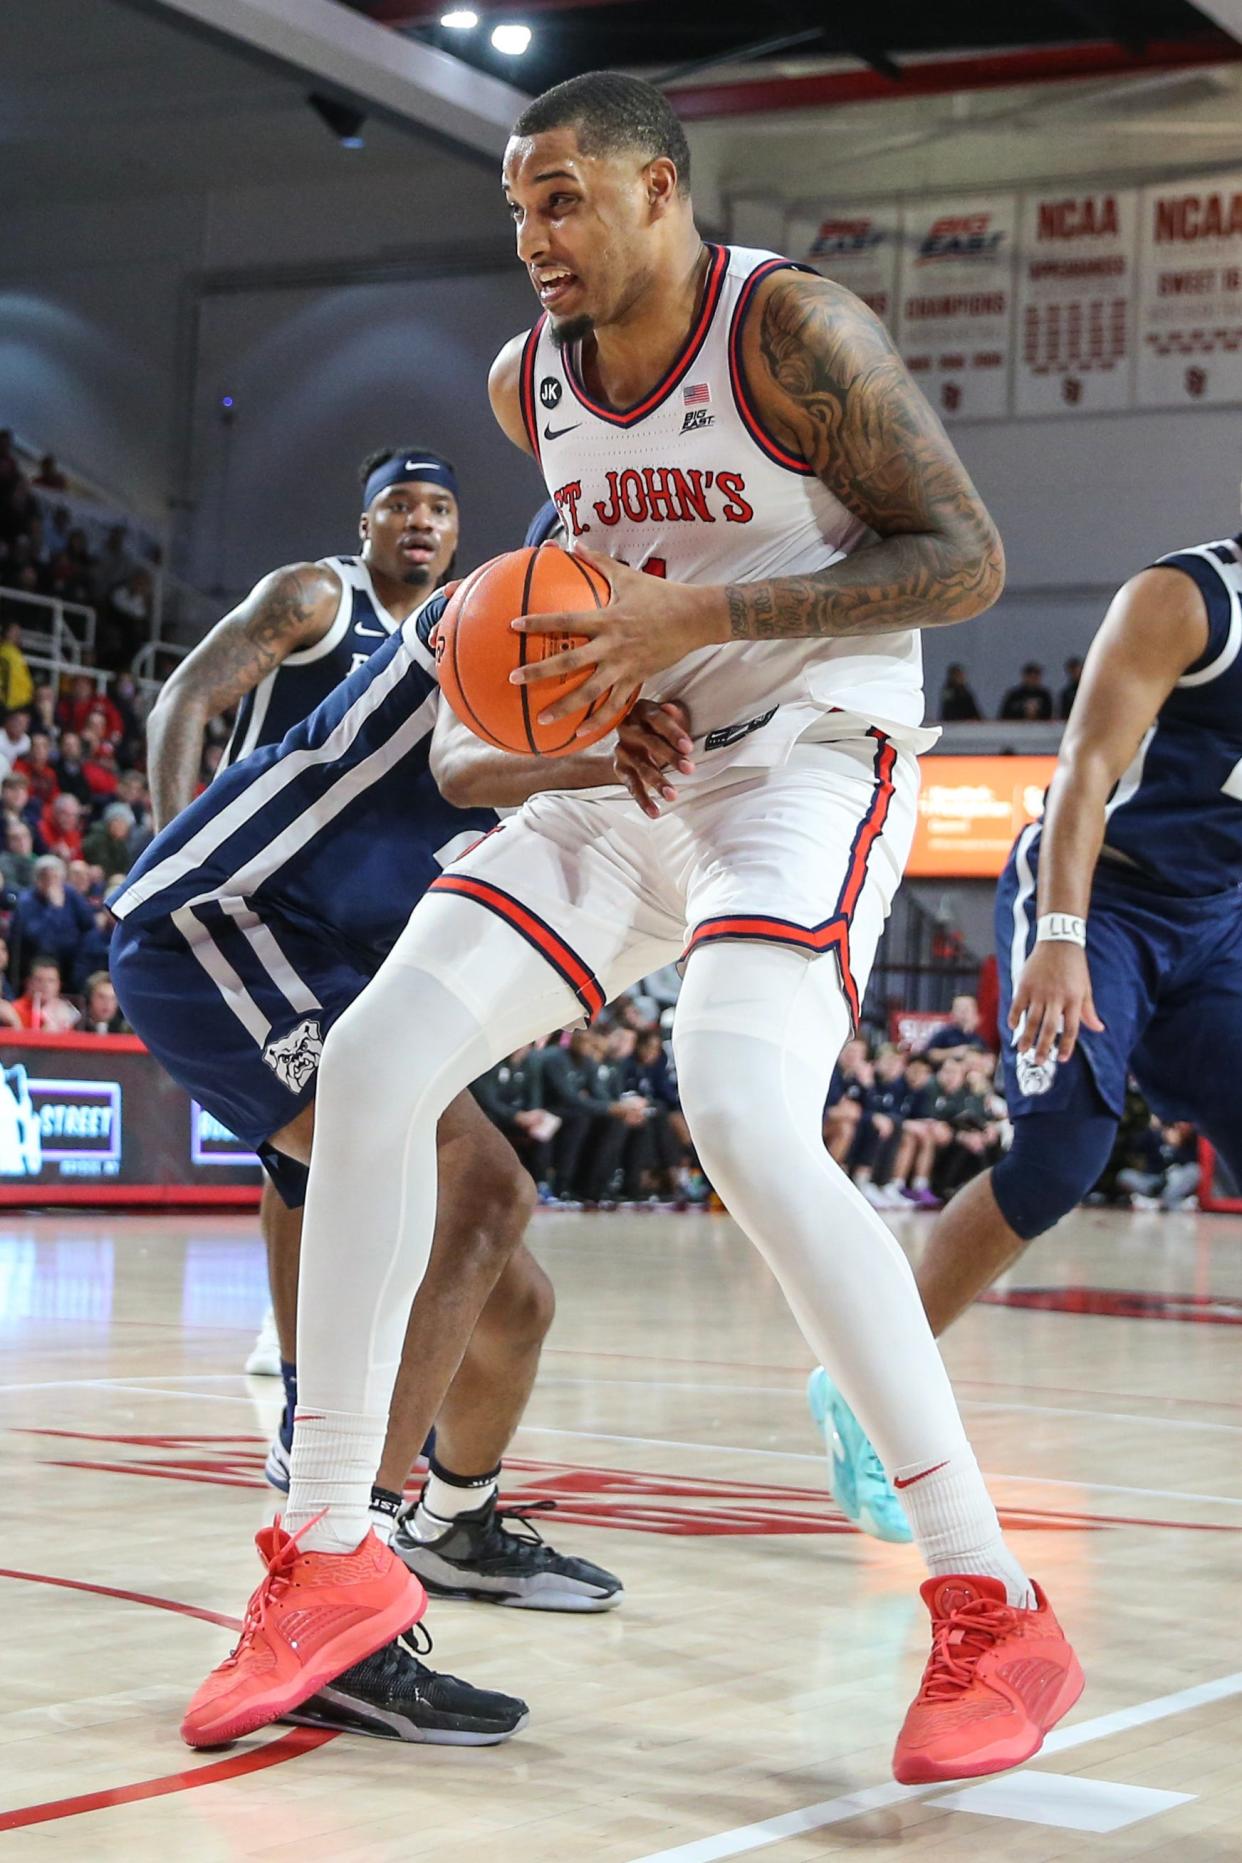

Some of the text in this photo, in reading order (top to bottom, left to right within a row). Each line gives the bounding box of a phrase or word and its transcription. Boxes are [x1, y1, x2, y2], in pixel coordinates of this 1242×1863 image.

[1038, 196, 1119, 240] NCAA
[905, 292, 1005, 320] CHAMPIONS
[541, 382, 558, 401] JK
[682, 415, 715, 429] EAST
[684, 409, 707, 422] BIG
[593, 468, 754, 525] JOHN'S
[41, 1104, 113, 1136] STREET
